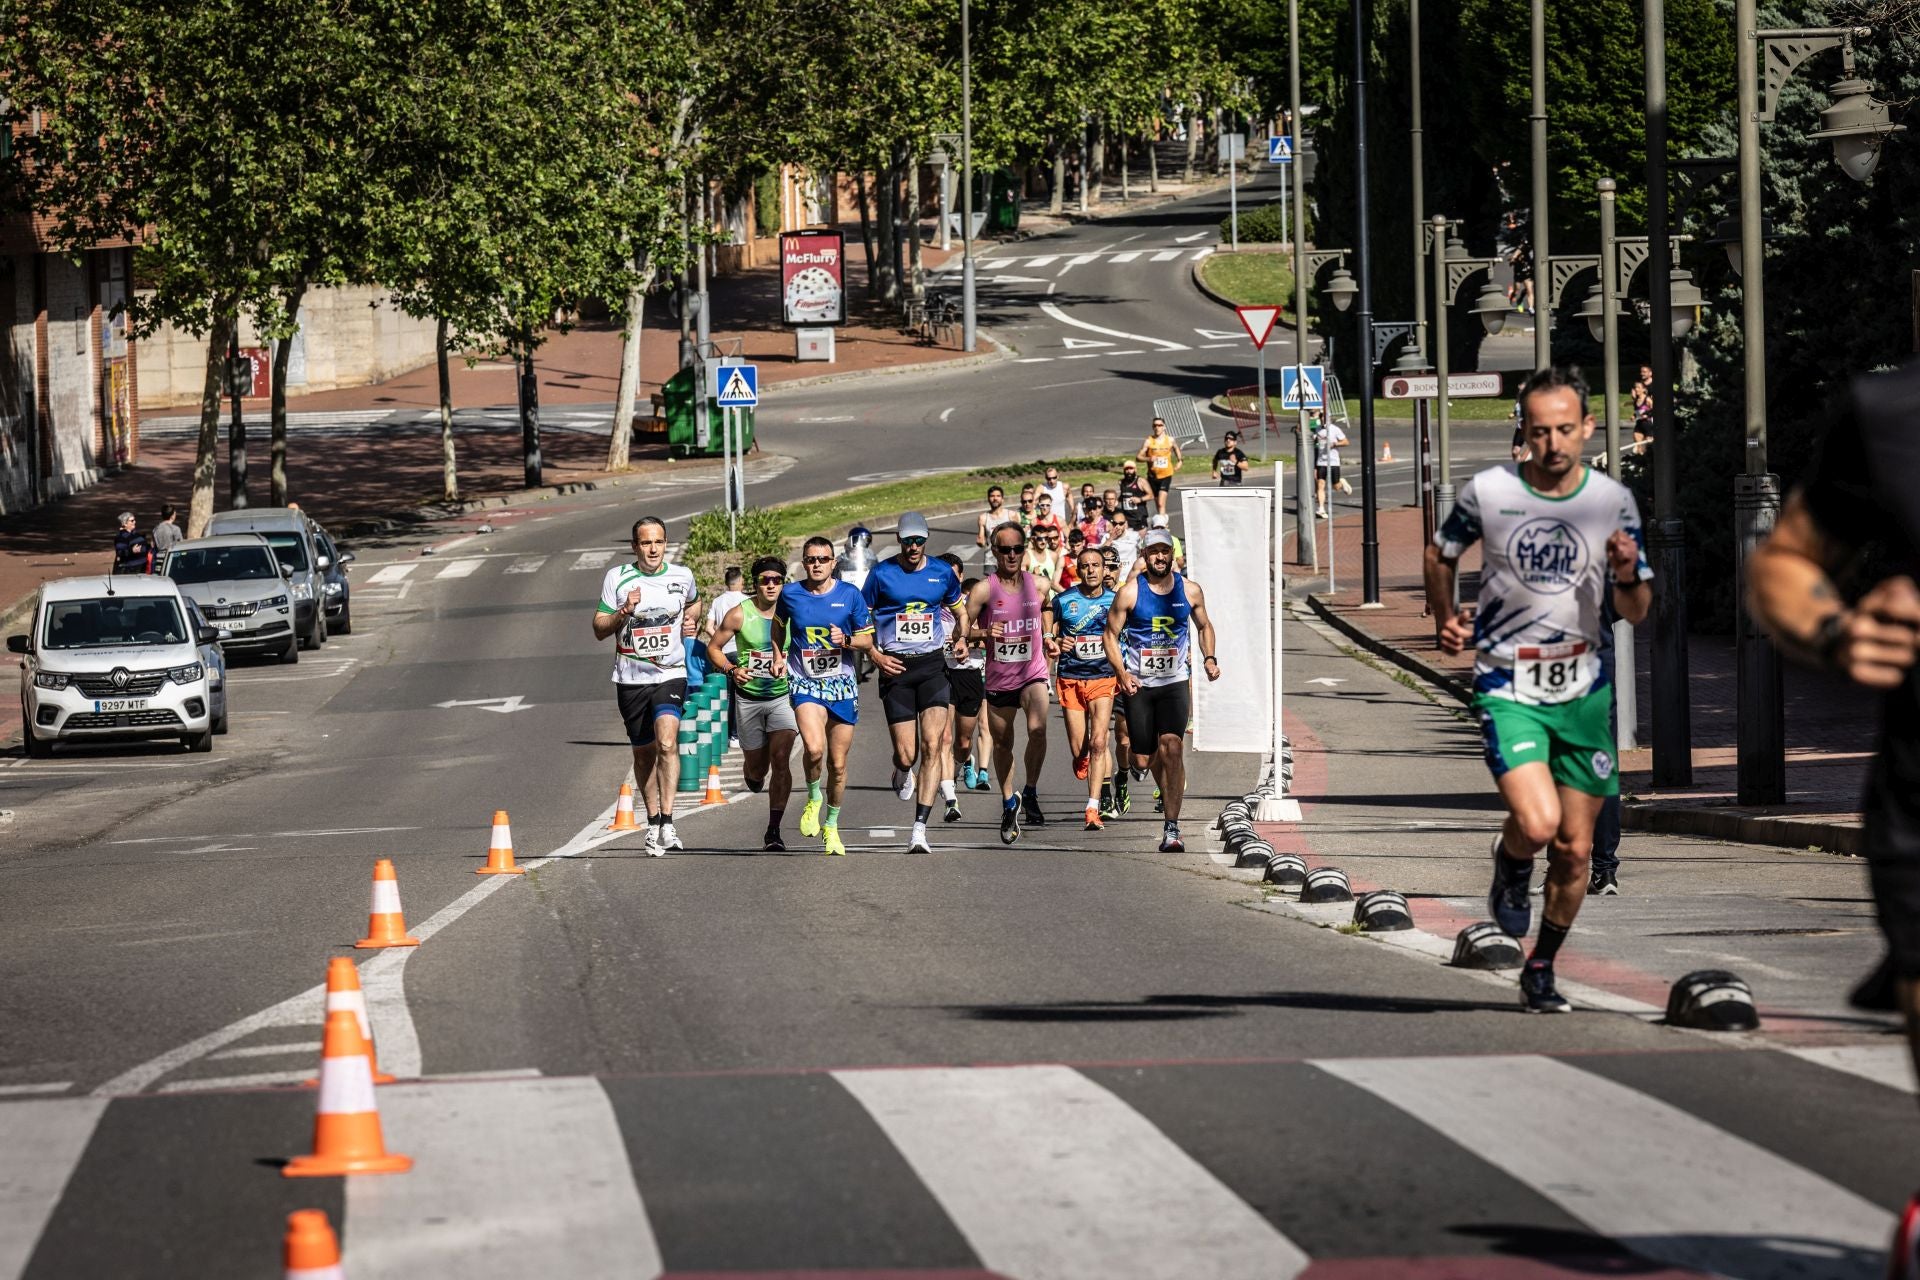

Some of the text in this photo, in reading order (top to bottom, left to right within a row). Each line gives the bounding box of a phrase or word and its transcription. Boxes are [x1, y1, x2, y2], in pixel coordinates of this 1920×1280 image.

[786, 253, 837, 265] McFlurry
[900, 621, 930, 639] 495
[1152, 616, 1179, 639] R
[637, 635, 669, 650] 205
[1080, 642, 1105, 653] 411
[997, 644, 1028, 656] 478
[807, 657, 839, 671] 192
[1145, 657, 1174, 670] 431
[1526, 659, 1579, 687] 181
[101, 701, 146, 711] 9297 MTF
